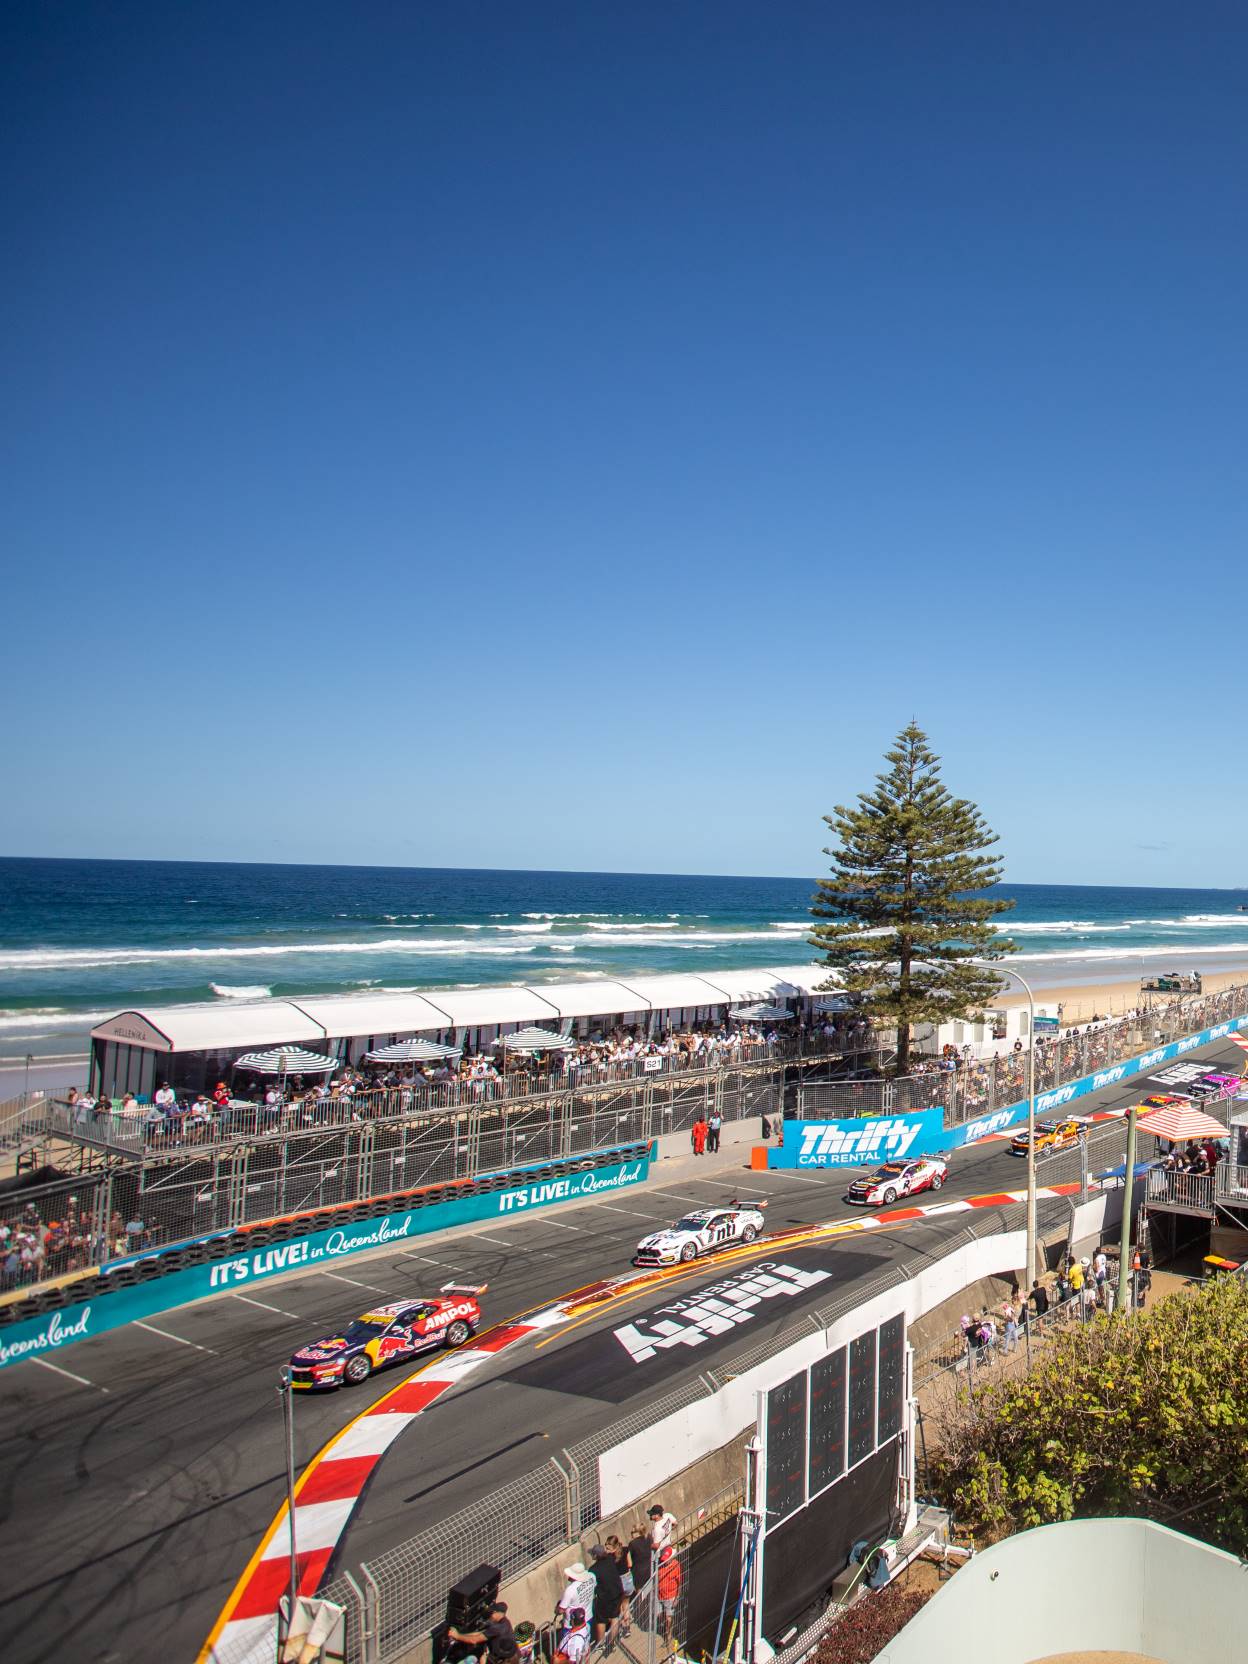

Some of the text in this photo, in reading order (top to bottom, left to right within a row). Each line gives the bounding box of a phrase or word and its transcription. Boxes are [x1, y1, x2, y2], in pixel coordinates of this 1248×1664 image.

[647, 1060, 660, 1068] S21
[1139, 1050, 1166, 1067] Thrifty
[1093, 1066, 1125, 1086] Thrifty
[1037, 1085, 1076, 1109] Thrifty
[800, 1119, 923, 1157] Thrifty
[966, 1110, 1015, 1138] Thrifty
[800, 1151, 880, 1164] CAR RENTAL
[499, 1163, 641, 1211] IT'S LIVE! in Queensland
[717, 1220, 735, 1242] nti
[210, 1215, 412, 1287] IT'S LIVE! in Queensland
[653, 1262, 776, 1315] CAR RENTAL
[424, 1301, 476, 1332] AMPOL
[613, 1264, 833, 1364] Thrifty
[0, 1306, 91, 1365] ueensland
